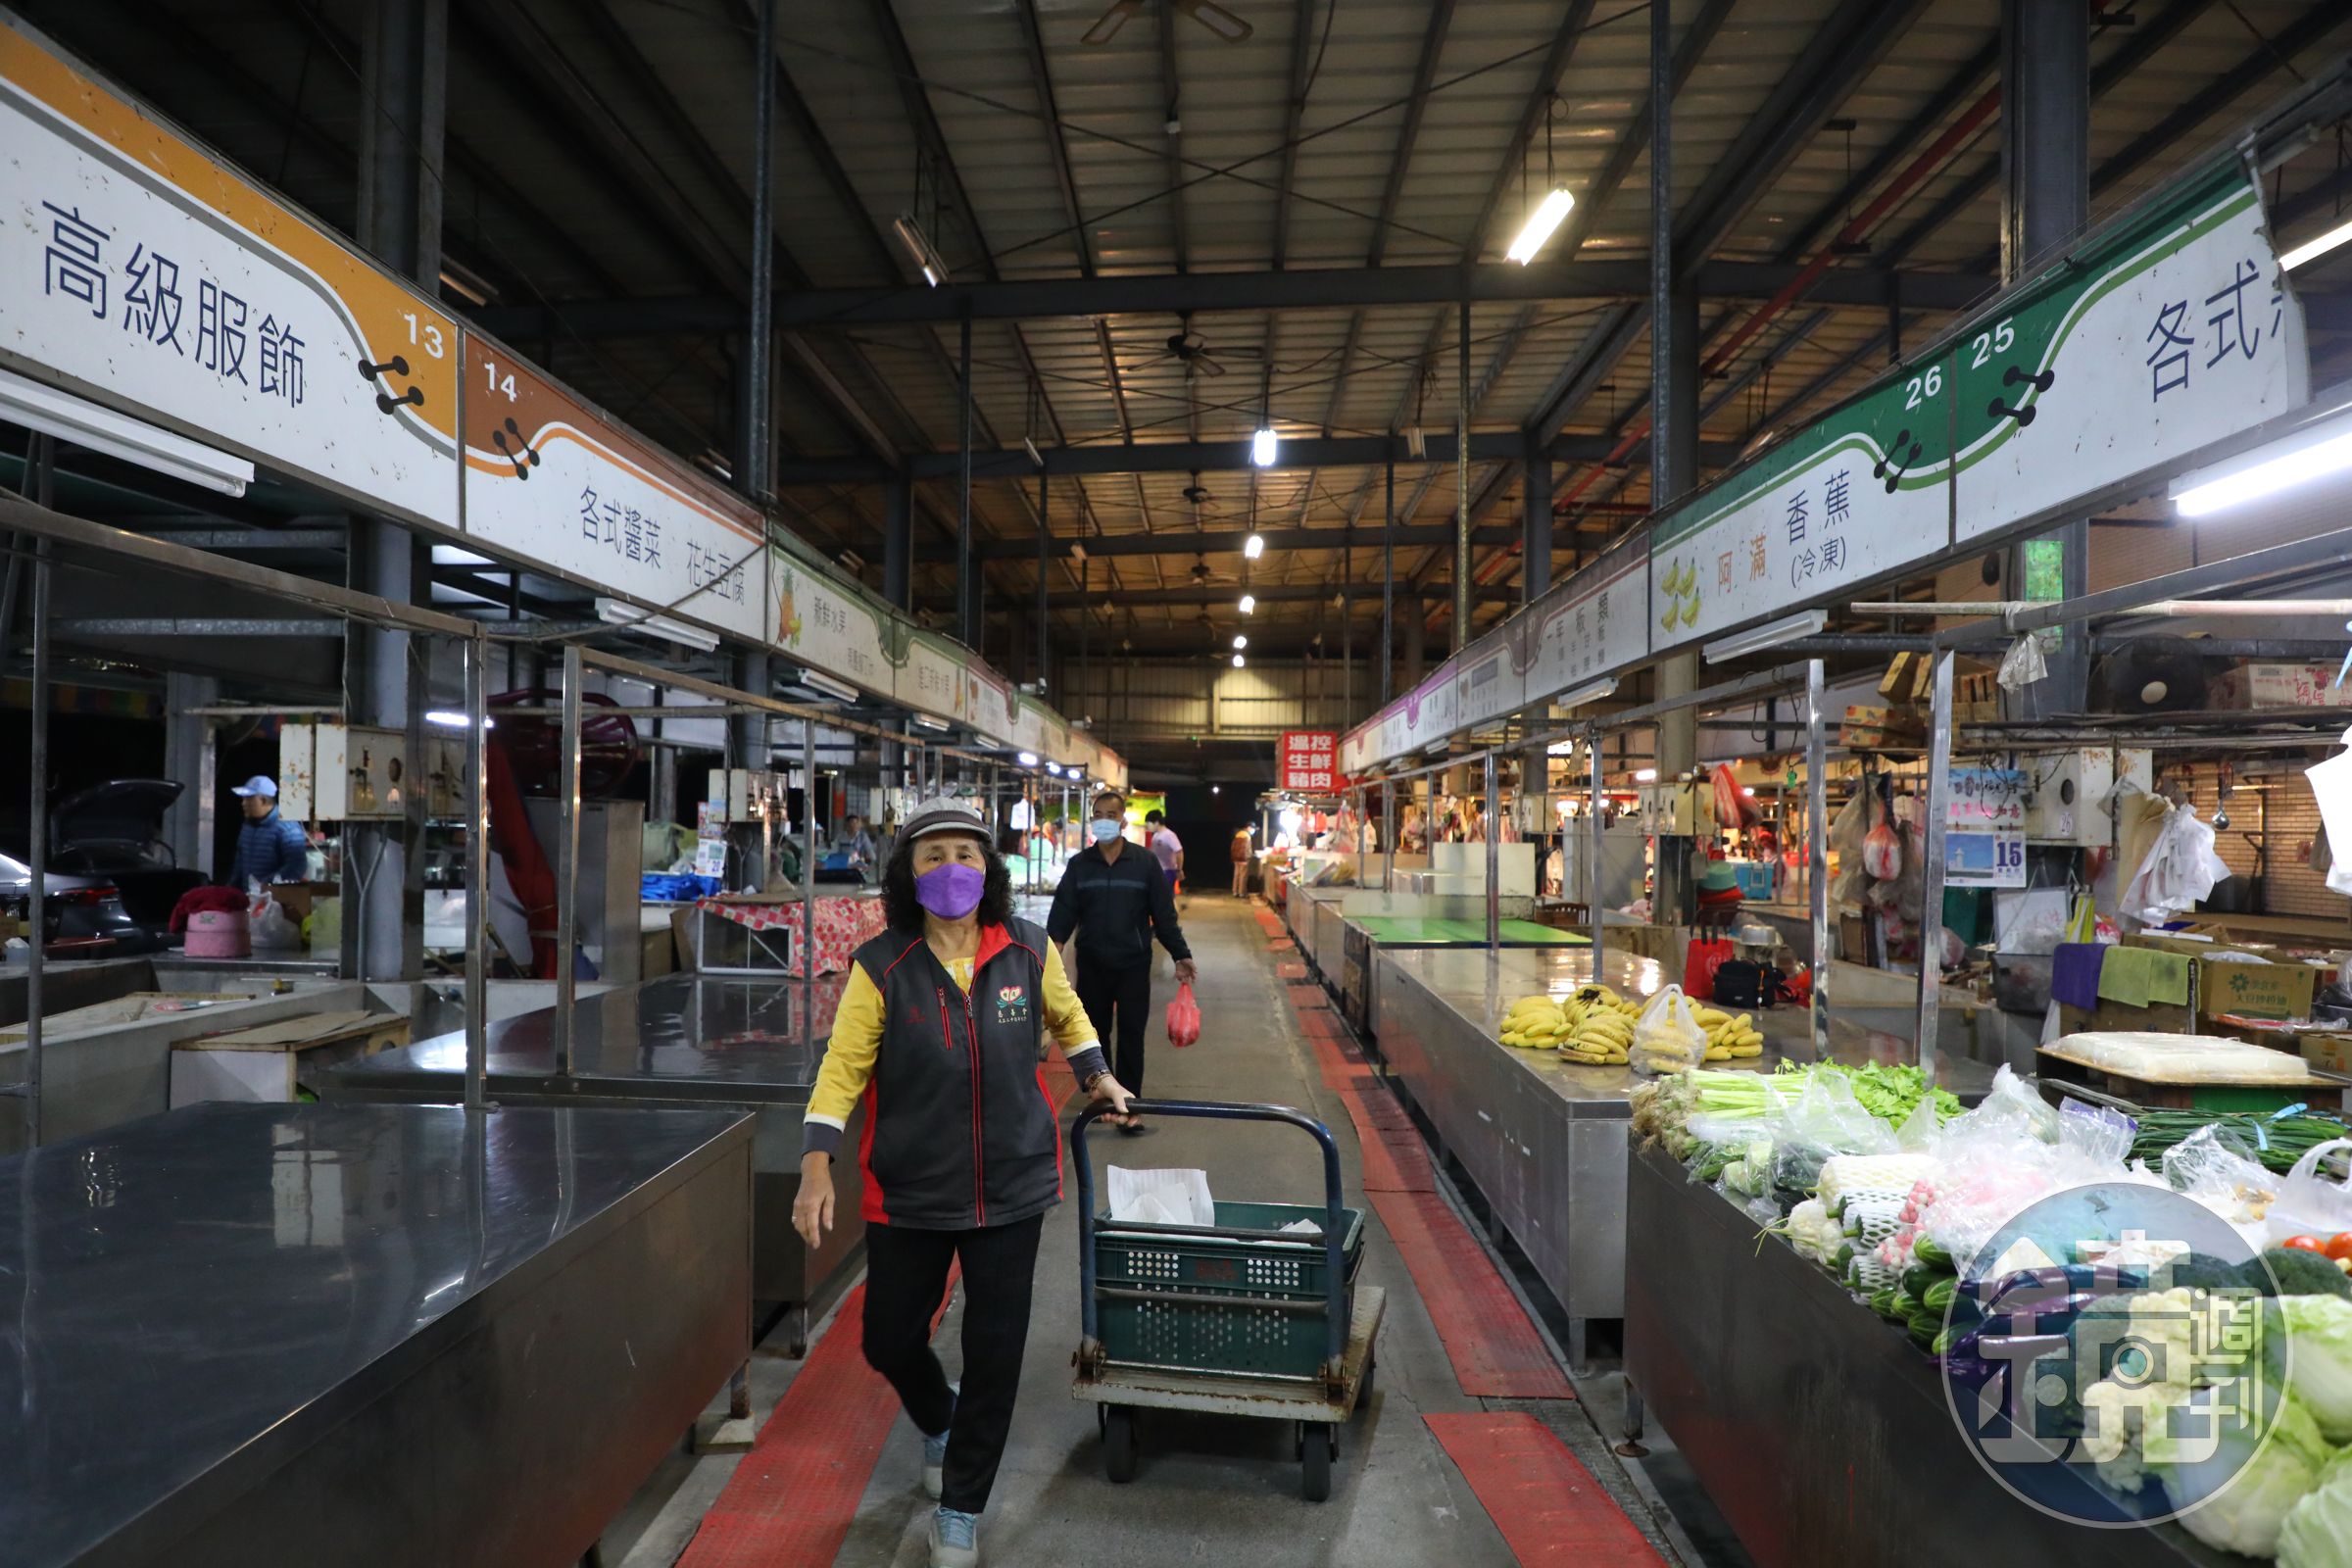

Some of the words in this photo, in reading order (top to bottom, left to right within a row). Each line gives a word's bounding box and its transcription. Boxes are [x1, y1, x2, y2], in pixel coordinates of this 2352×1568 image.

[42, 200, 306, 408] 高級服飾
[404, 314, 444, 359] 13
[1972, 316, 2015, 370] 25
[2146, 259, 2283, 403] 各式
[484, 362, 517, 402] 14
[1905, 366, 1941, 411] 26
[580, 485, 661, 569] 各式醬菜
[1787, 468, 1849, 546] 香蕉
[1288, 754, 1332, 769] 生鮮
[2062, 812, 2072, 833] 26
[1996, 842, 2022, 866] 15
